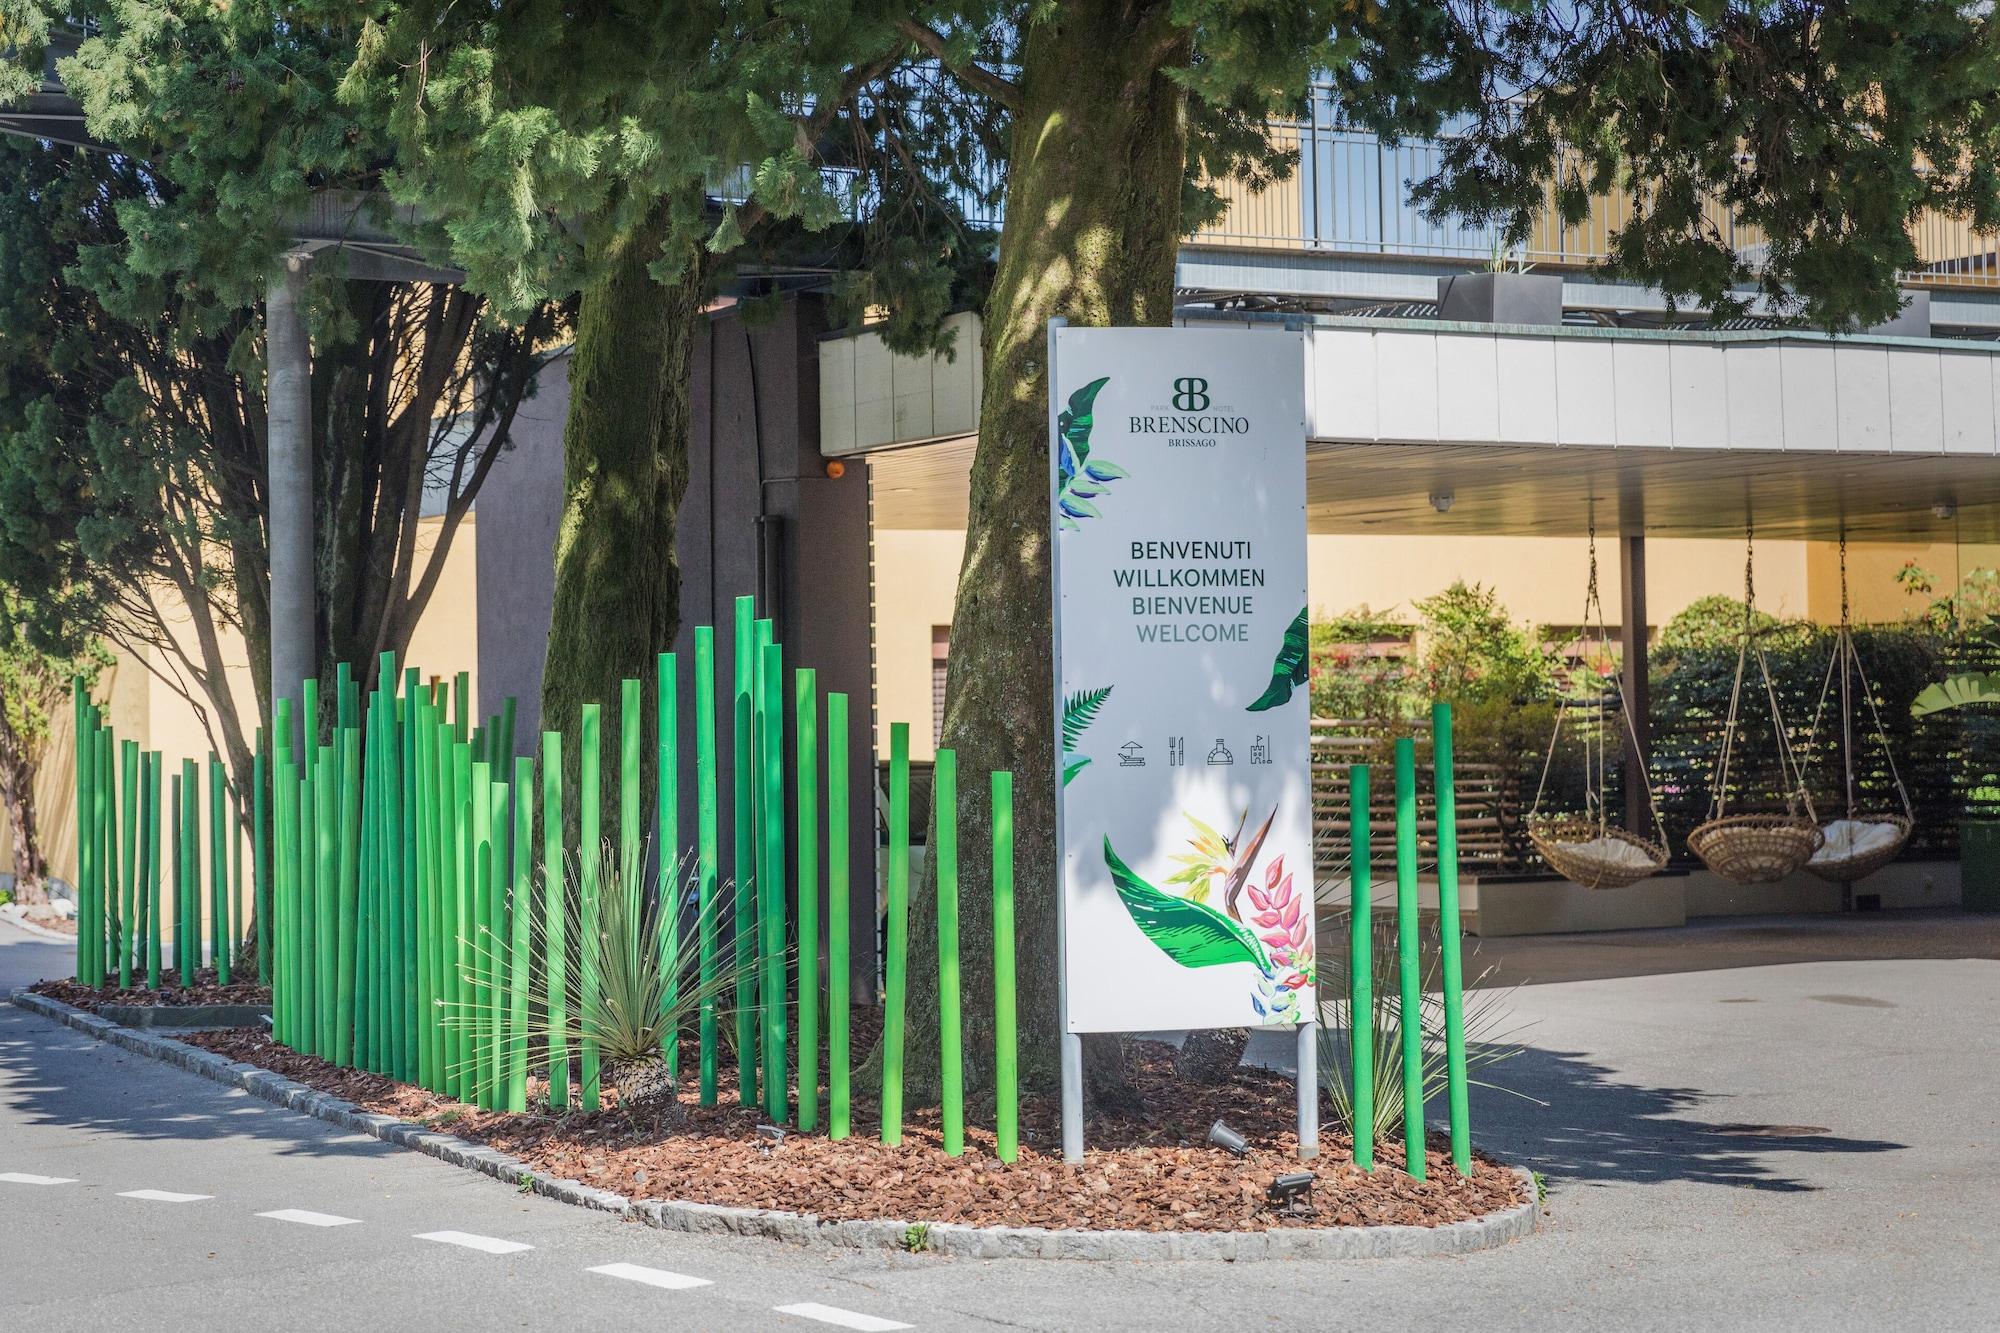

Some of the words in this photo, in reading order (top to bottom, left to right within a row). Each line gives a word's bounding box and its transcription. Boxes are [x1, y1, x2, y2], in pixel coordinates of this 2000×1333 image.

[1129, 416, 1249, 434] BRENSCINO
[1168, 438, 1216, 448] BRISSAGO
[1131, 541, 1251, 559] BENVENUTI
[1113, 568, 1265, 587] WILLKOMMEN
[1133, 596, 1253, 615] BIENVENUE
[1136, 624, 1249, 643] WELCOME
